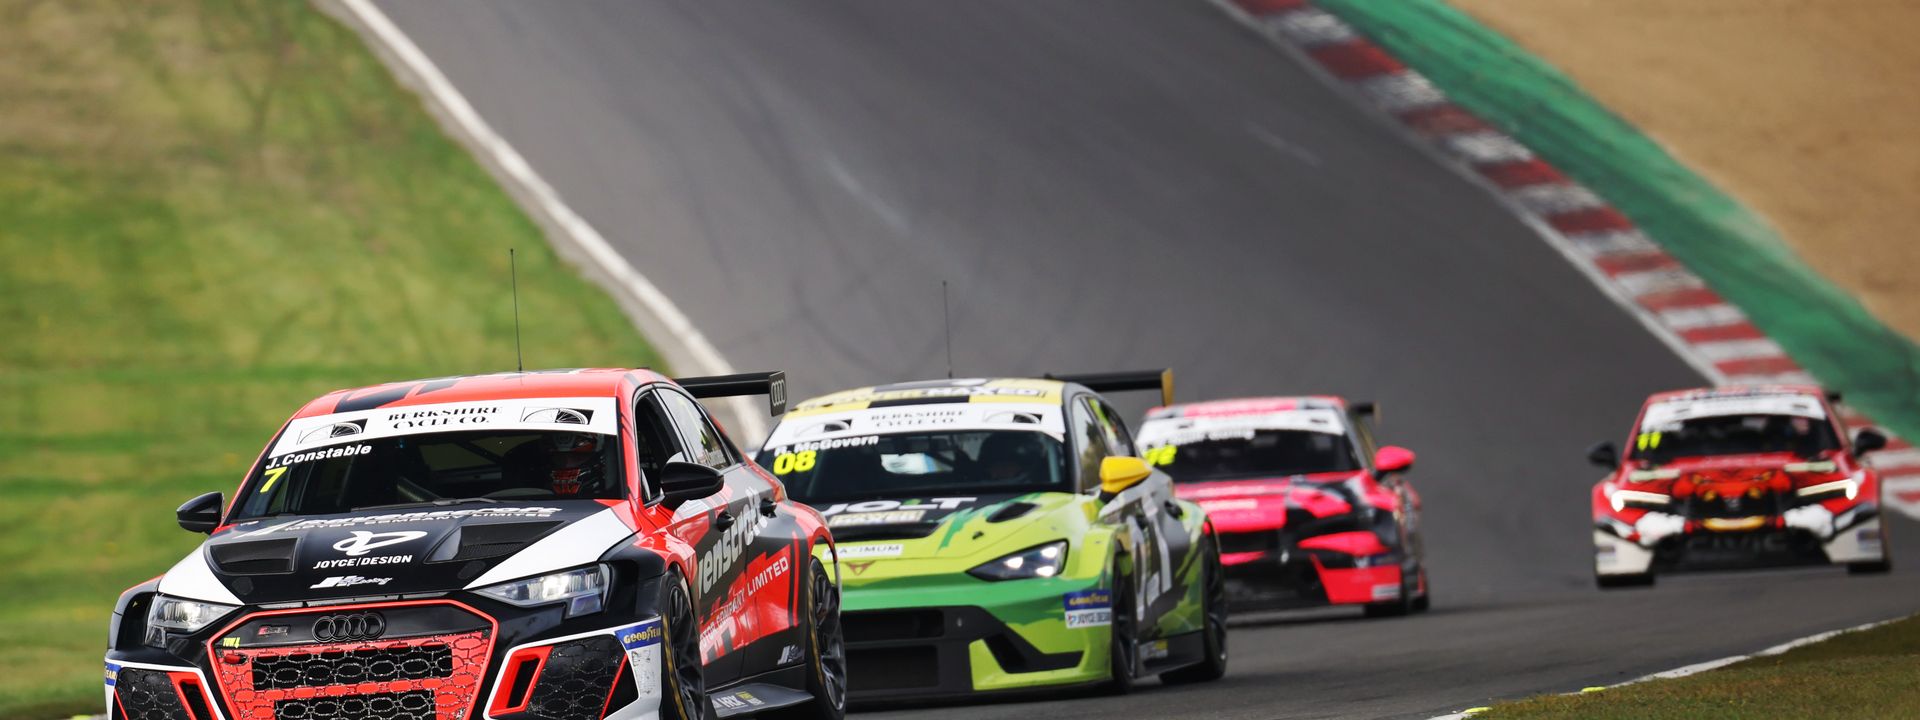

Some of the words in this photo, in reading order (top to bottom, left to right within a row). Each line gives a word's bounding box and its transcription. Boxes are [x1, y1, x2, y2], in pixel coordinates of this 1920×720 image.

[388, 406, 501, 421] BERKSHIRE
[393, 417, 450, 429] CYCLE
[459, 415, 490, 425] CO.
[871, 409, 967, 421] BERKSHIRE
[793, 435, 879, 453] McGovern
[773, 449, 816, 475] 08
[260, 466, 288, 493] 7
[822, 497, 977, 516] JOLT
[698, 487, 768, 598] enscroft
[747, 556, 789, 597] LIMITED
